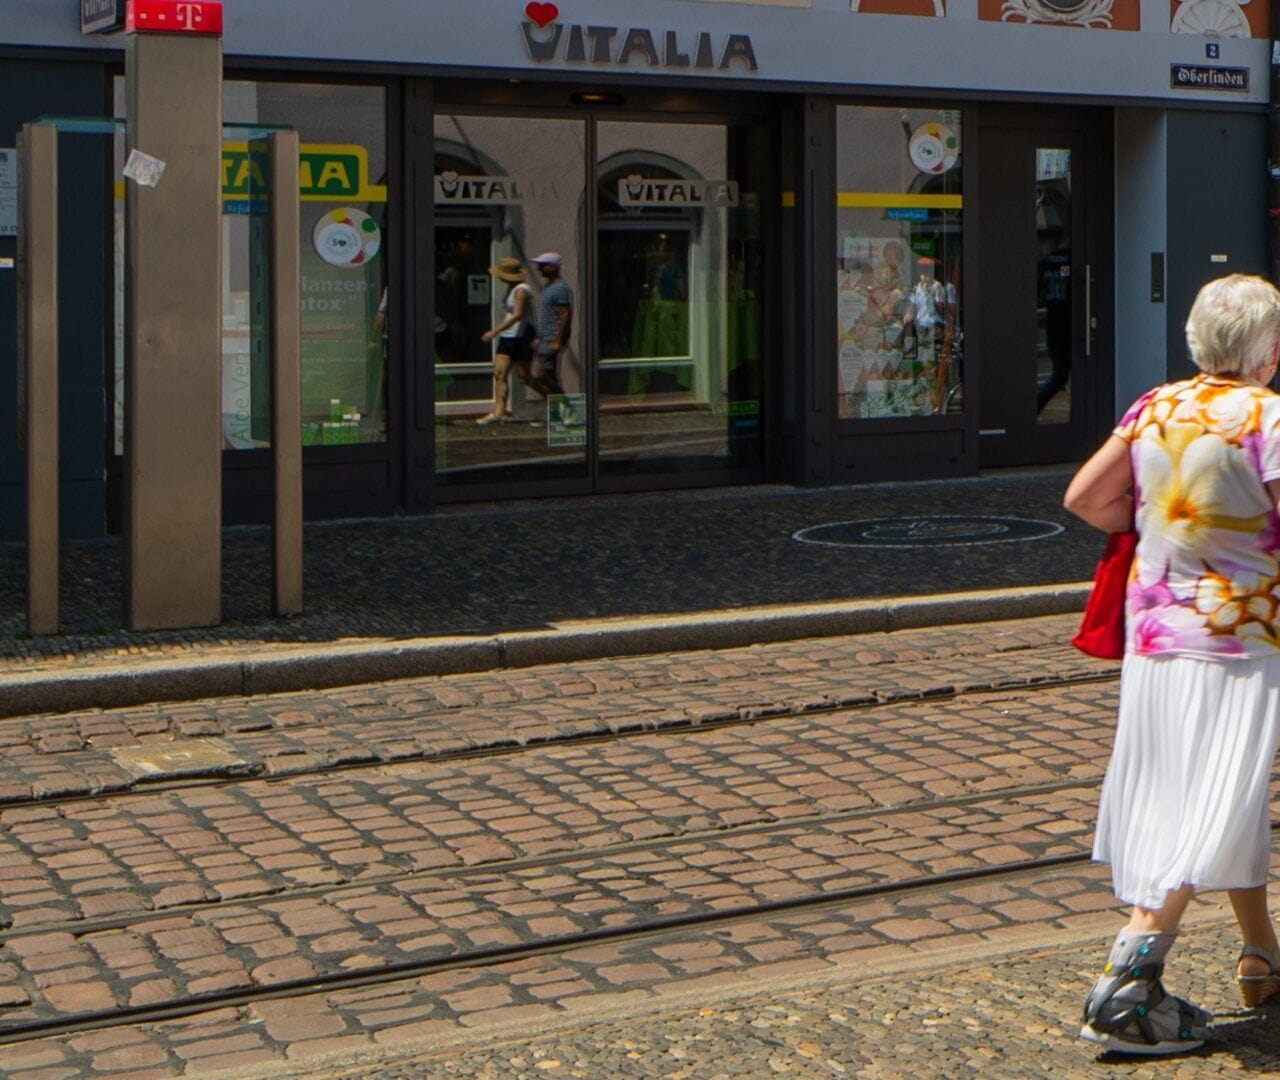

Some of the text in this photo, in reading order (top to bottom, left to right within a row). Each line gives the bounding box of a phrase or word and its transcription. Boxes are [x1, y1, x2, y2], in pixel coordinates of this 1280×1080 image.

[519, 21, 758, 70] VITALIA
[1209, 45, 1217, 57] 2
[1178, 67, 1245, 86] Oberlinden
[625, 182, 733, 202] VITALIA
[231, 355, 250, 394] Ver
